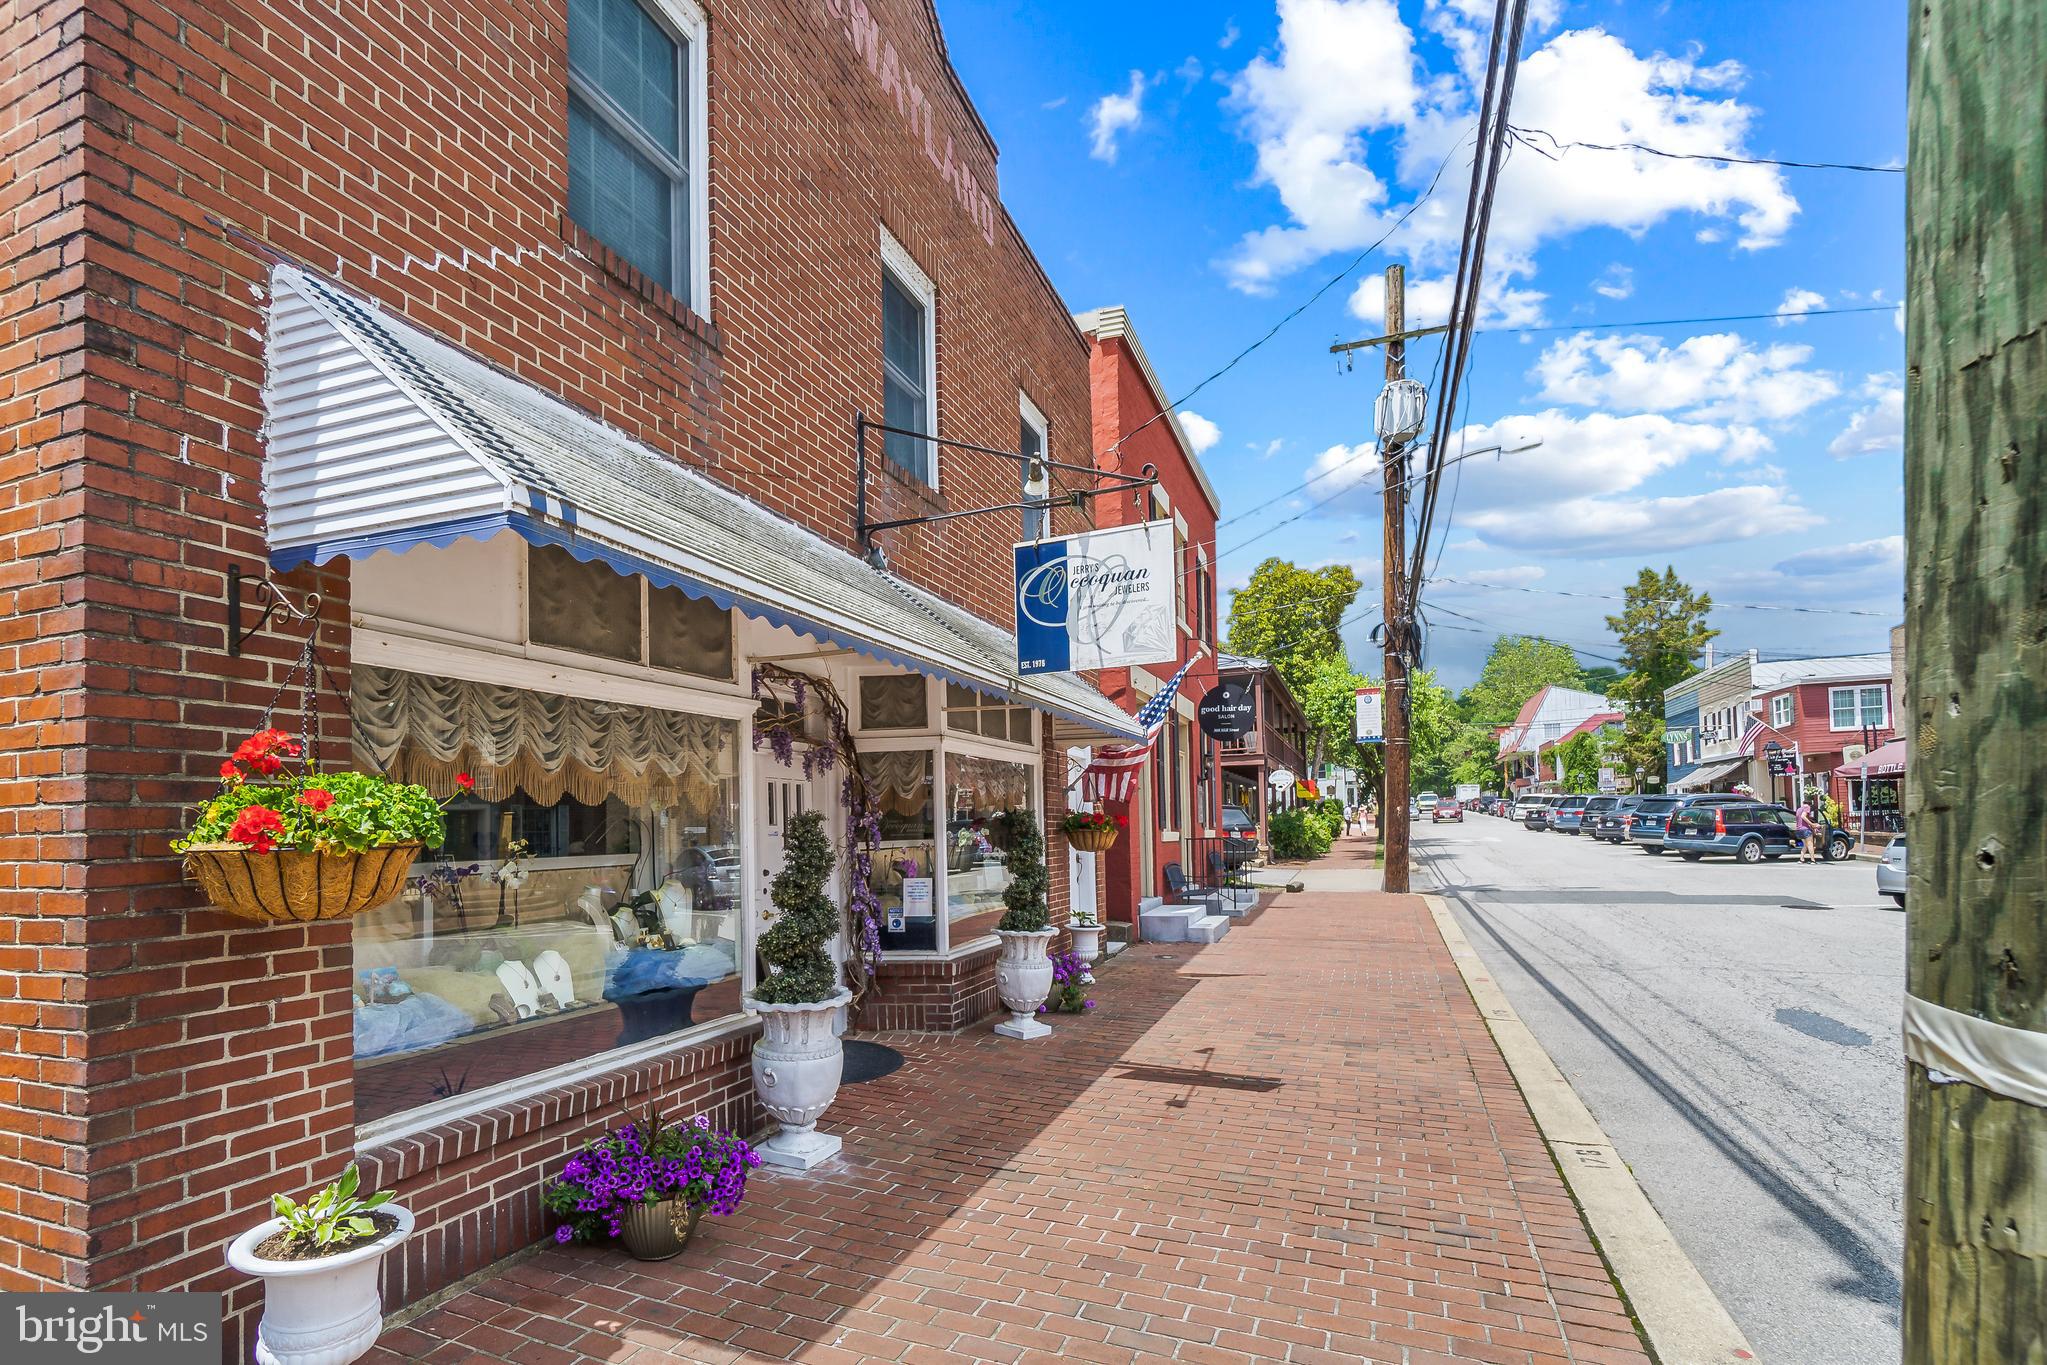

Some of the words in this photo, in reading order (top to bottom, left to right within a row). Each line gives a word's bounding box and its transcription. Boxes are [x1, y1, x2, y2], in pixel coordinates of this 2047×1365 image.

[1114, 582, 1150, 596] JEWELERS
[1020, 661, 1031, 669] EST.
[1200, 705, 1220, 715] good
[1221, 704, 1237, 712] hair
[1238, 704, 1252, 713] day
[1877, 763, 1904, 774] BOTTLE
